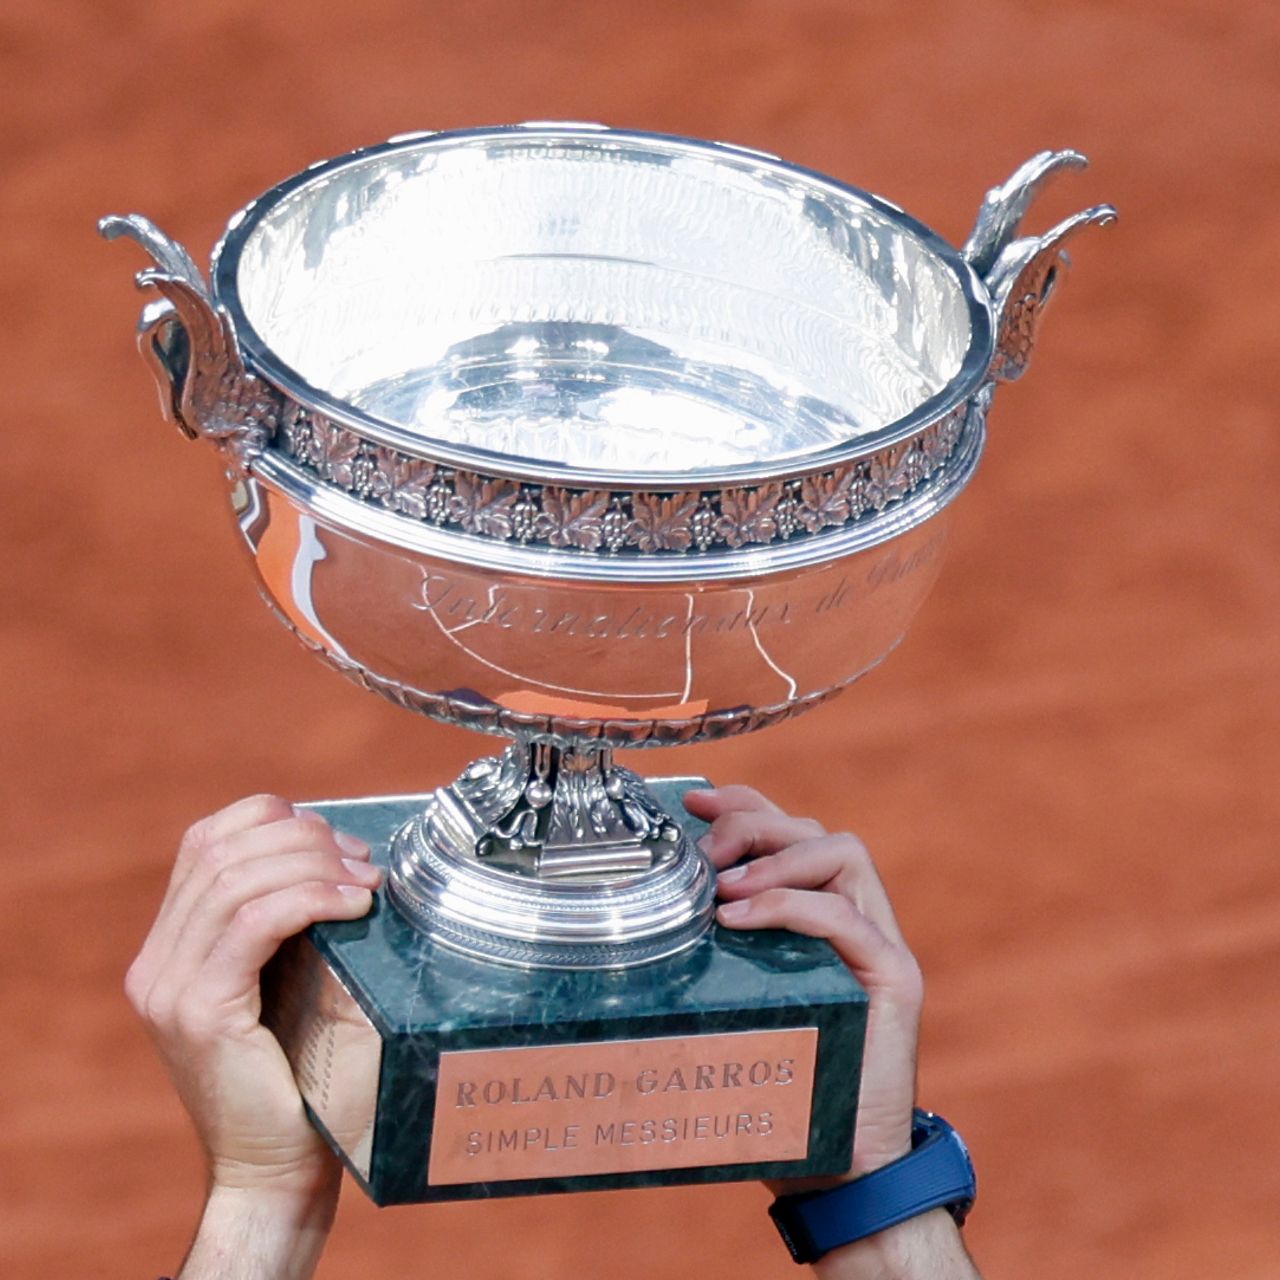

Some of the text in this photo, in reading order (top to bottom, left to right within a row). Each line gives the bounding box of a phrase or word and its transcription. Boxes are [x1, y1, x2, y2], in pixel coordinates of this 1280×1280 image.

[455, 1059, 795, 1108] ROLAND GARROS
[466, 1112, 773, 1156] SIMPLE MESSIEURS
